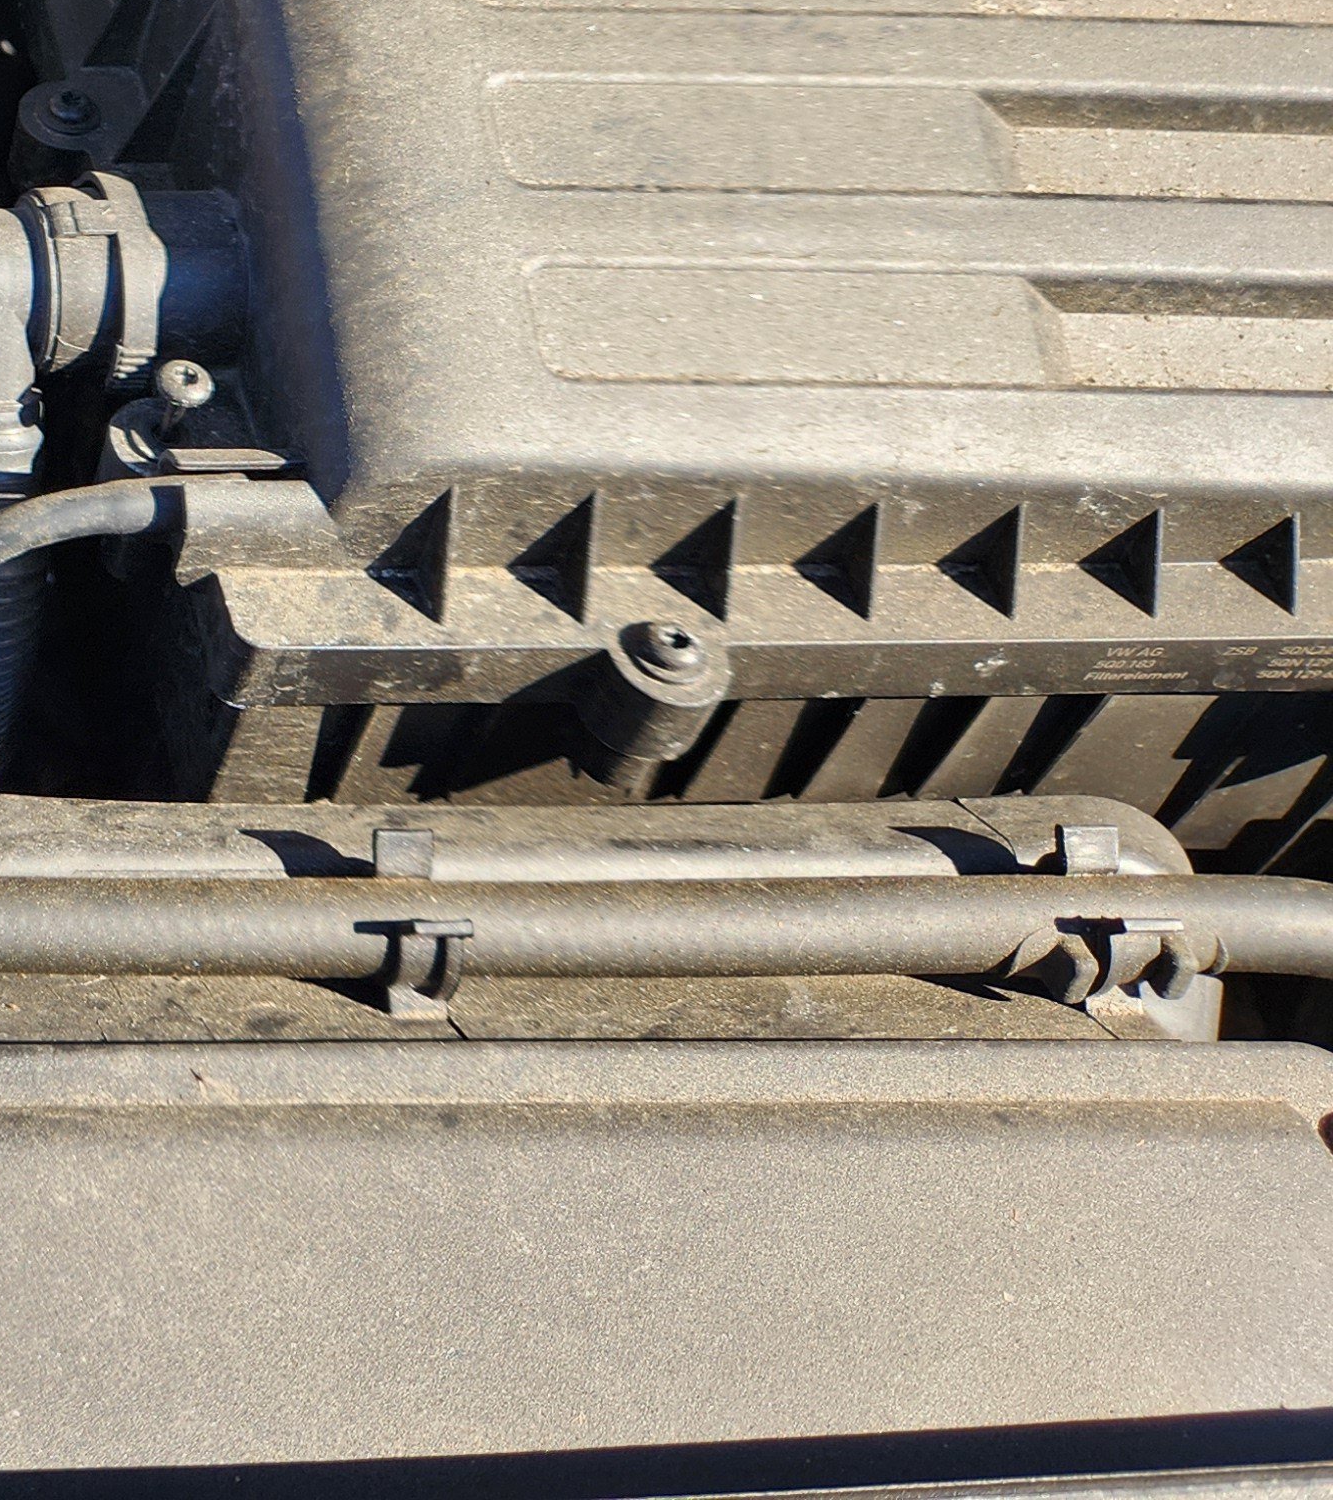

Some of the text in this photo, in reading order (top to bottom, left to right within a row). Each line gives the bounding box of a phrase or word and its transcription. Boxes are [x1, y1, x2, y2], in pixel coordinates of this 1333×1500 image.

[1106, 647, 1165, 657] VW AG
[1083, 671, 1190, 681] Filterelement
